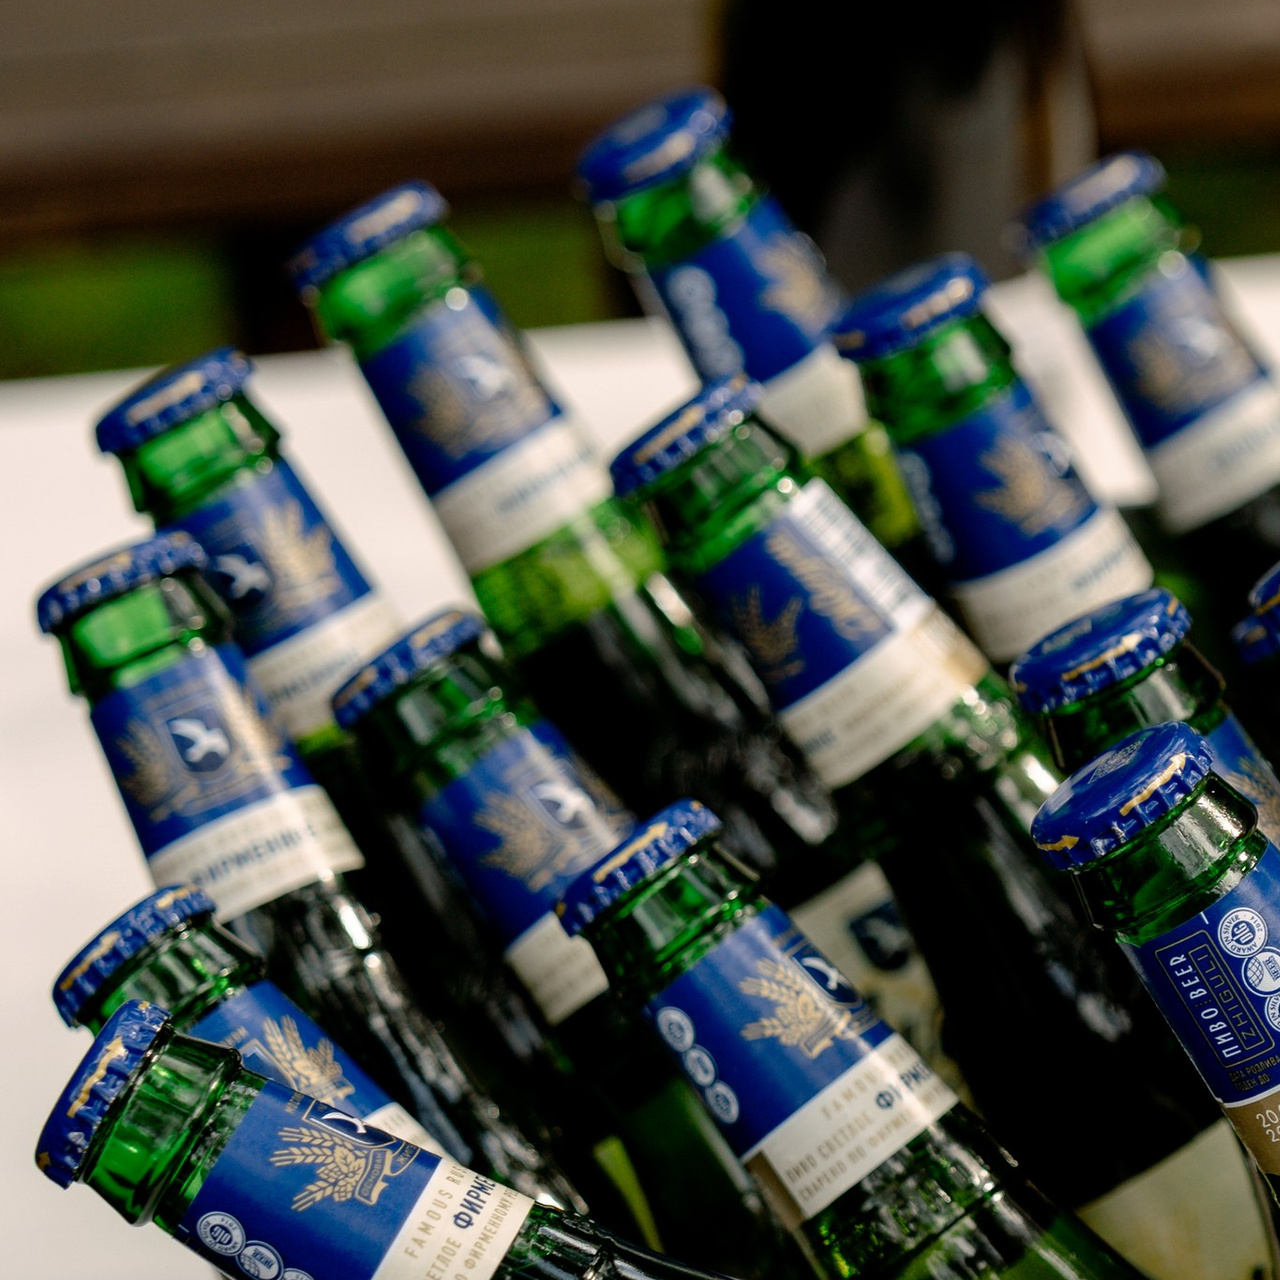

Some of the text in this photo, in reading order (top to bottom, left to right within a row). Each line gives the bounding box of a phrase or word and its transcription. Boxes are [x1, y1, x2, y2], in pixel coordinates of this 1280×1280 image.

[1168, 952, 1242, 1058] ПИВО BEER
[1196, 953, 1257, 1041] ZHIGULI
[404, 1189, 454, 1260] FAMOUS
[463, 1196, 514, 1270] ФИРМЕННОМУ
